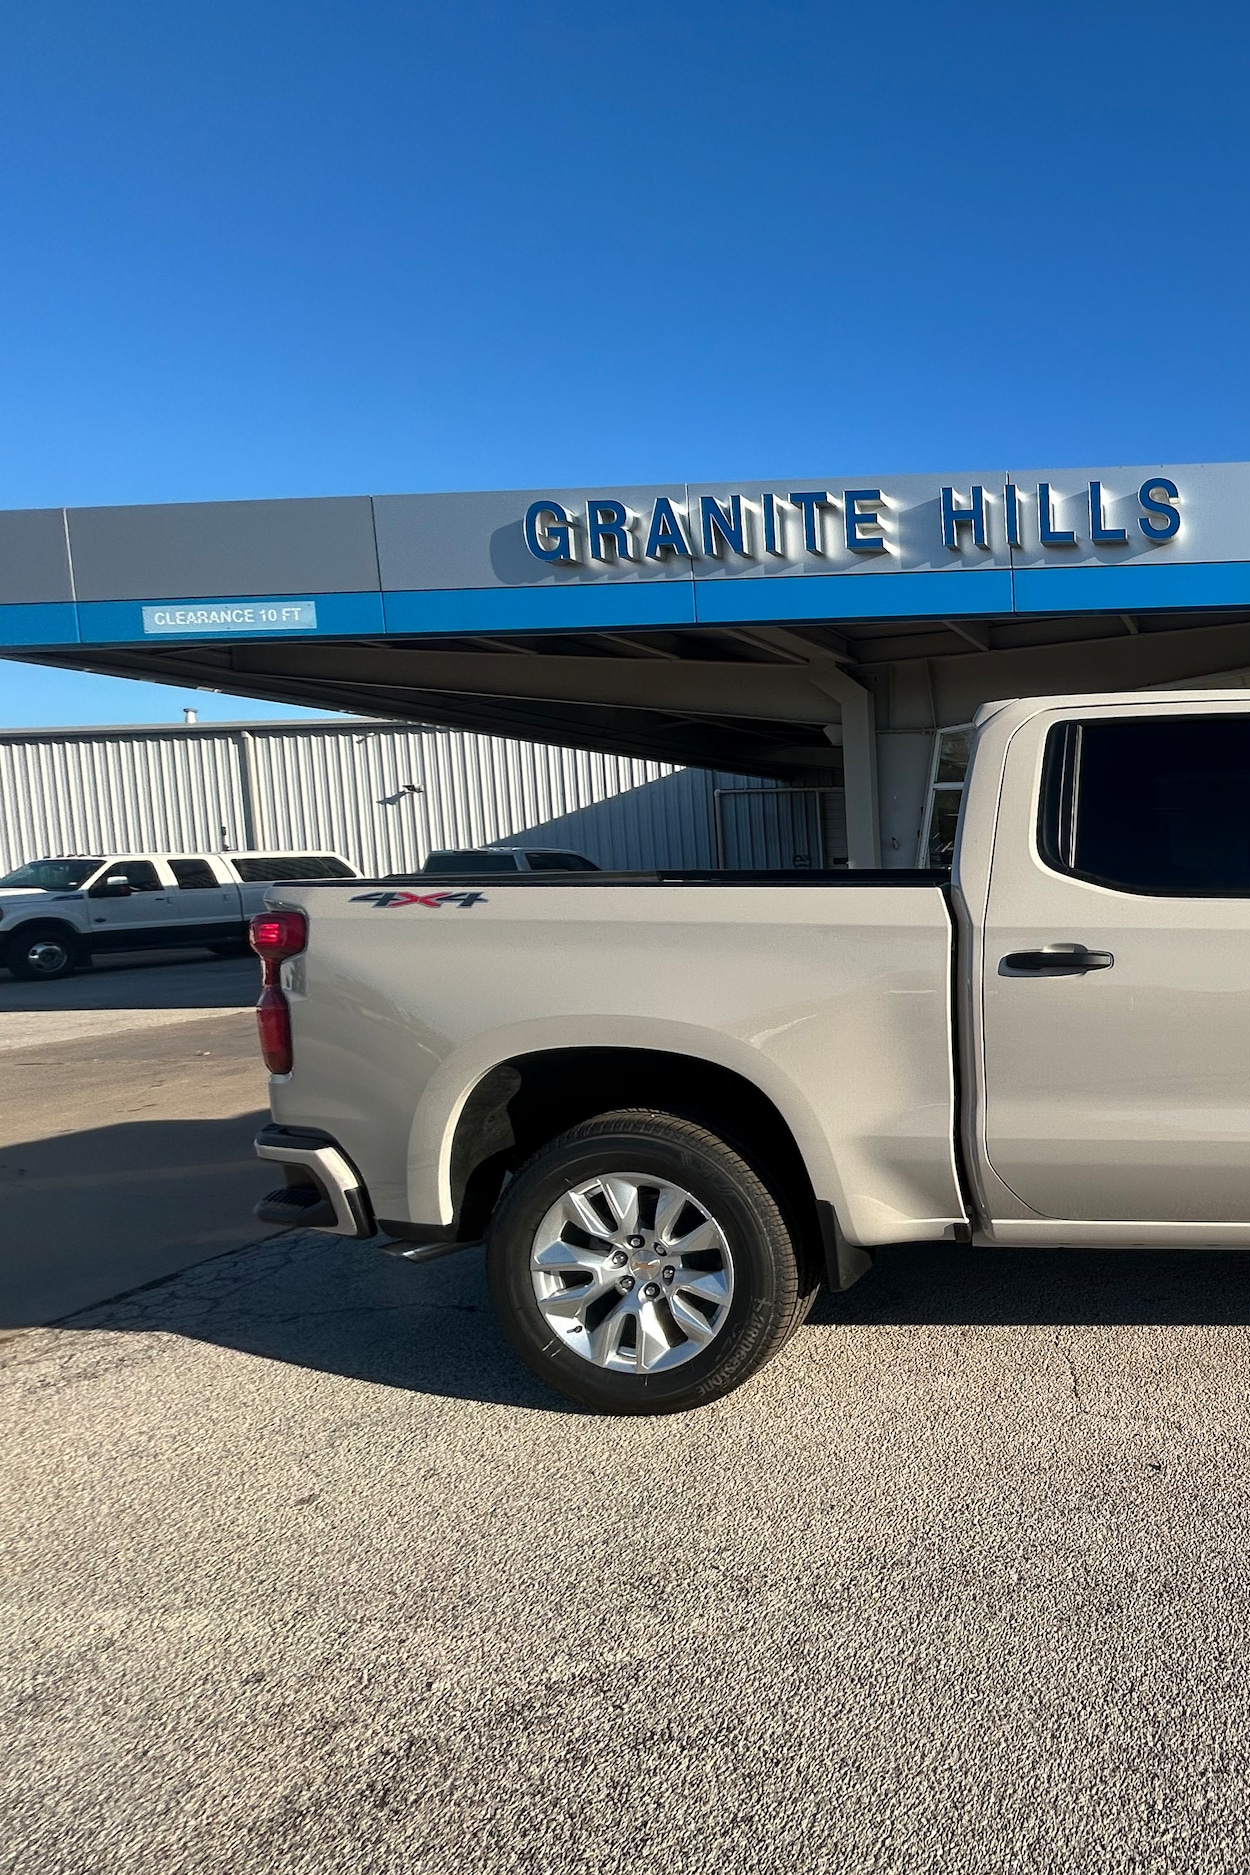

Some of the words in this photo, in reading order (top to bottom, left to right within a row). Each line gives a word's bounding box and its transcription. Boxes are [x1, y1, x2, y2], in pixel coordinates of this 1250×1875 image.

[522, 489, 889, 562] GRANITE
[939, 477, 1182, 548] HILLS
[153, 609, 255, 625] CLEARANCE
[259, 608, 277, 622] 10
[281, 607, 302, 621] FT
